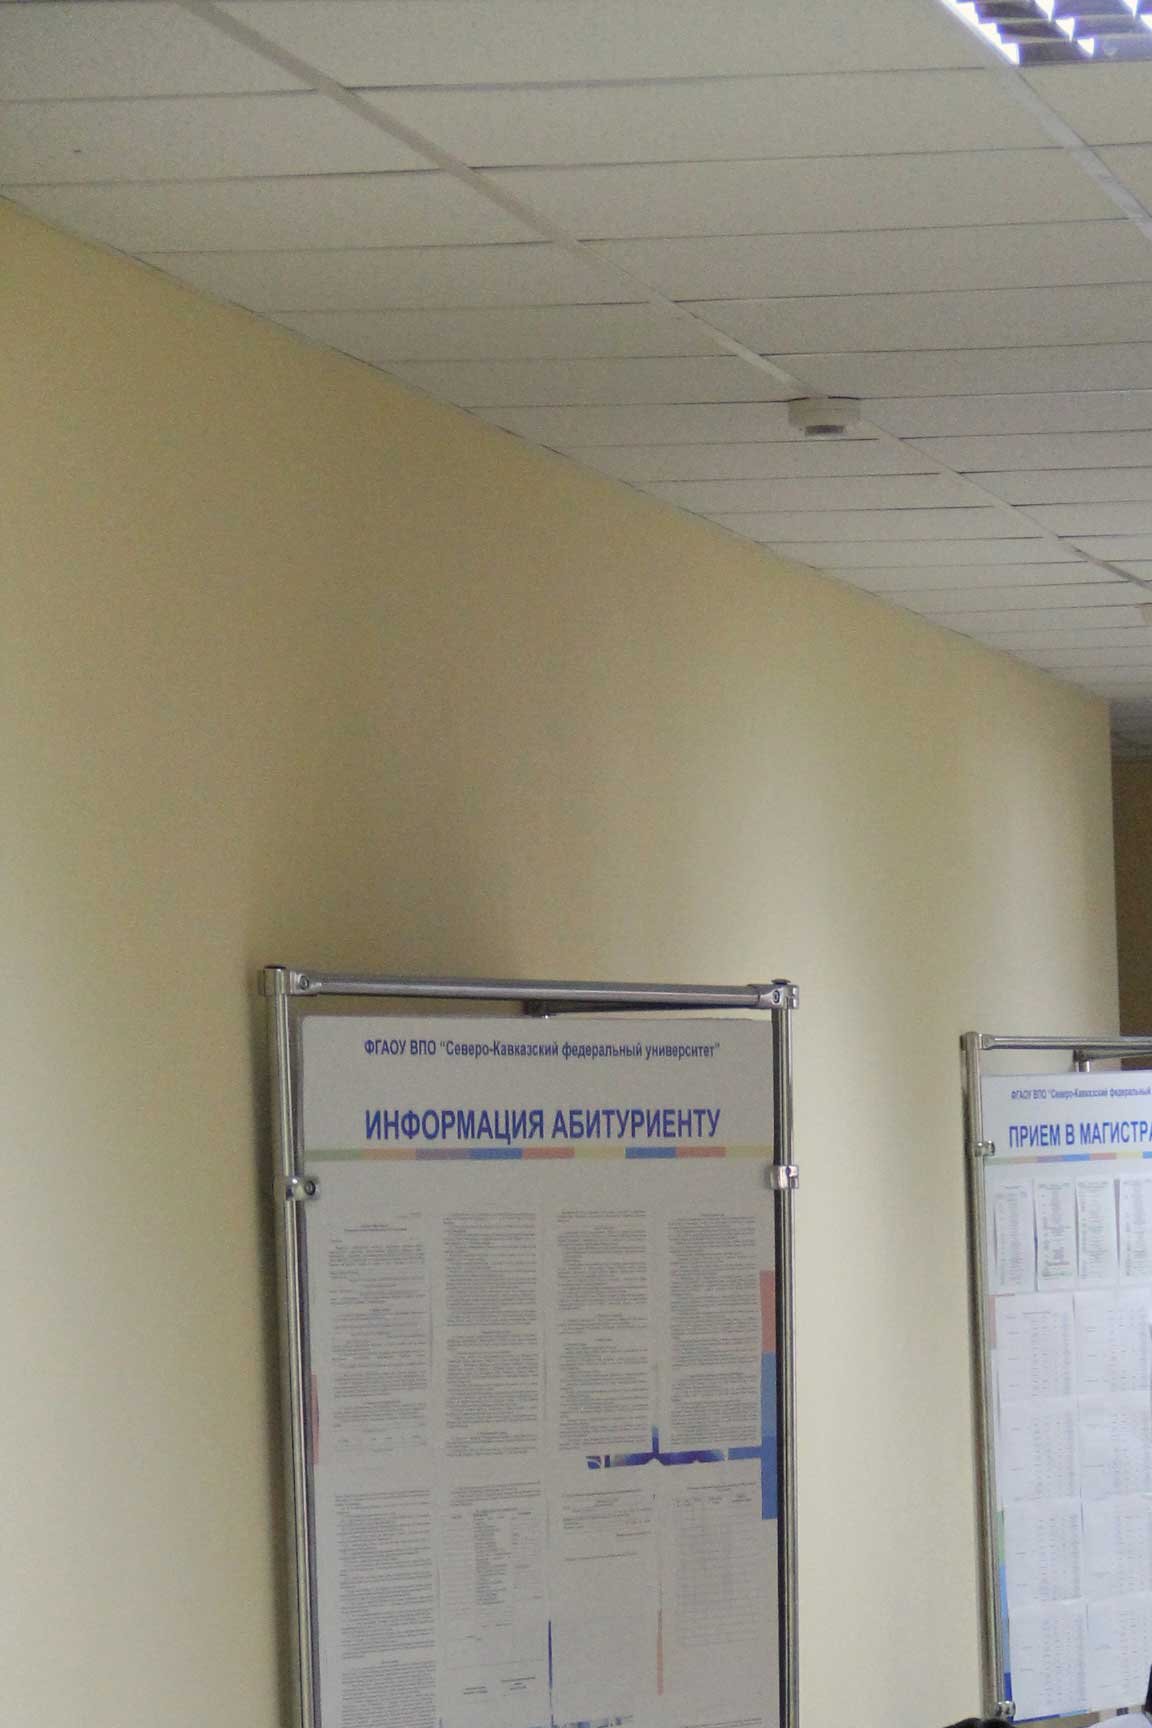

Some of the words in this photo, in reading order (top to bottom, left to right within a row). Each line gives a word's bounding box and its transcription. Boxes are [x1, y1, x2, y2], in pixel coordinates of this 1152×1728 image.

[364, 1039, 407, 1056] ФГАОУ
[410, 1040, 436, 1056] ВПО
[562, 1041, 643, 1060] федеральный
[365, 1109, 544, 1145] ИНФОРМАЦИЯ
[551, 1108, 721, 1139] АБИТУРИЕНТУ
[1009, 1123, 1061, 1148] ПРИЕМ
[1065, 1123, 1075, 1145] В
